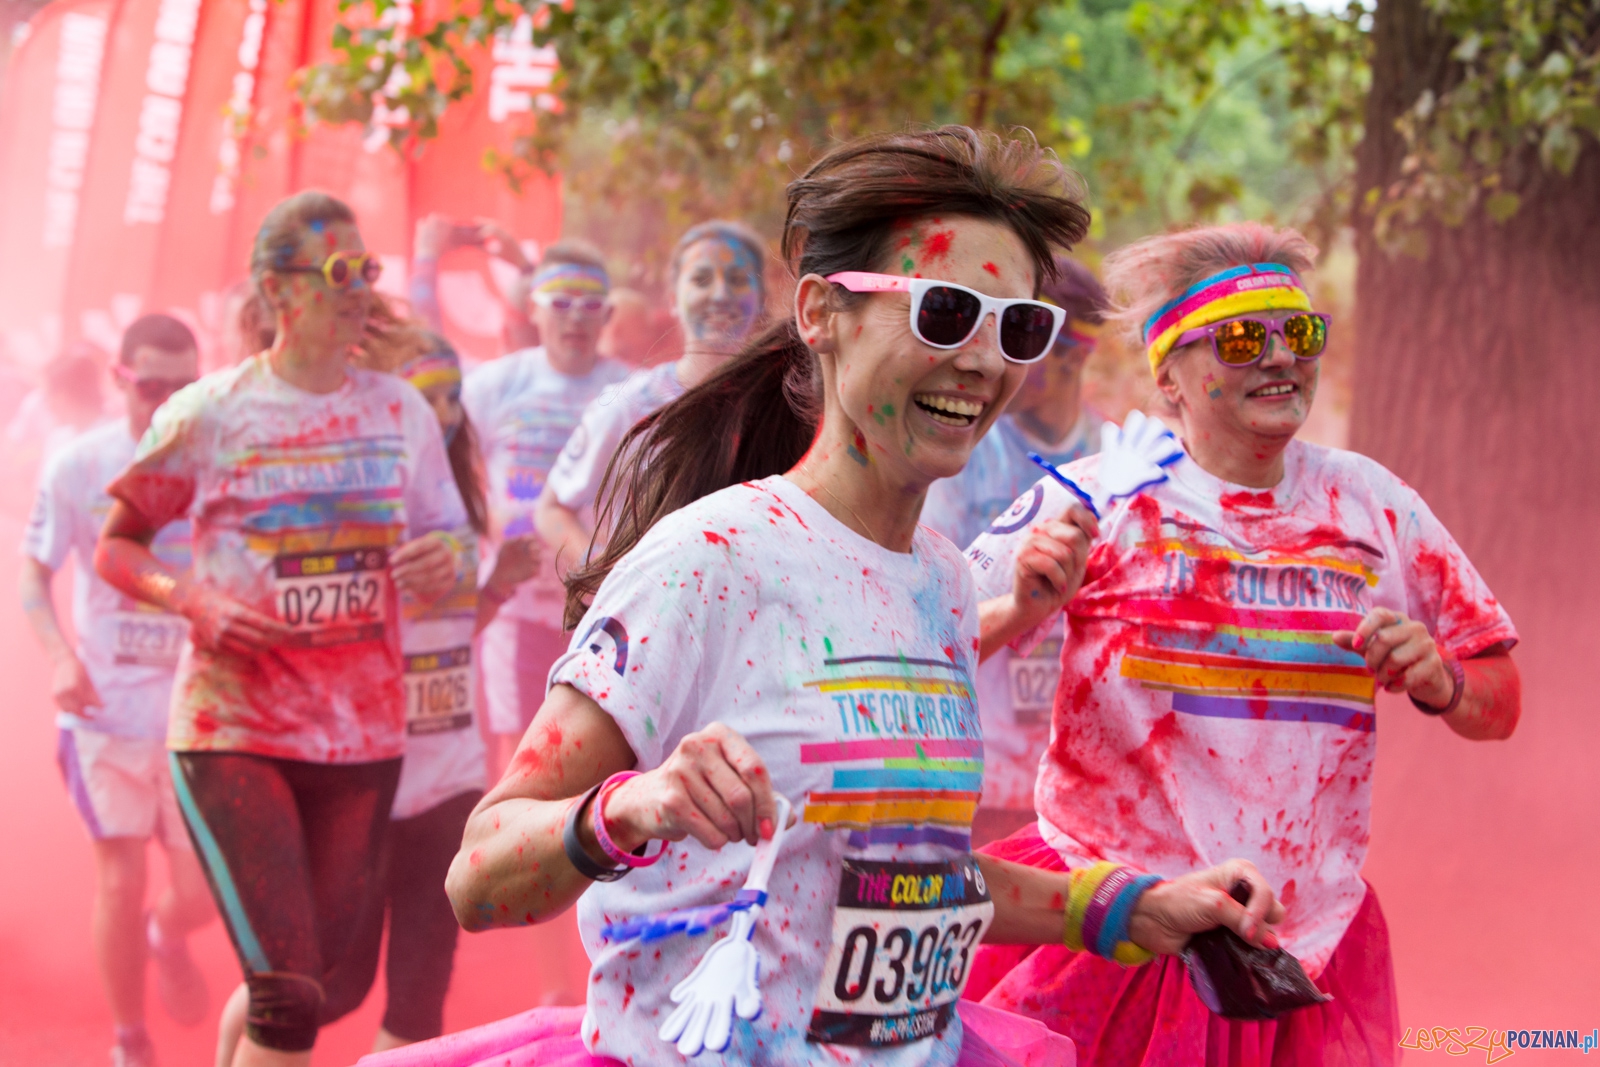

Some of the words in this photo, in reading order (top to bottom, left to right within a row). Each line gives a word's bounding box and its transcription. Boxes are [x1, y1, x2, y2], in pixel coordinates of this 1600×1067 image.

[283, 578, 380, 627] 02762
[403, 674, 469, 714] 1026
[831, 693, 881, 737] THE
[880, 692, 942, 737] COLOR
[857, 873, 892, 904] THE
[890, 873, 944, 905] COLOR
[834, 917, 983, 1004] 03963
